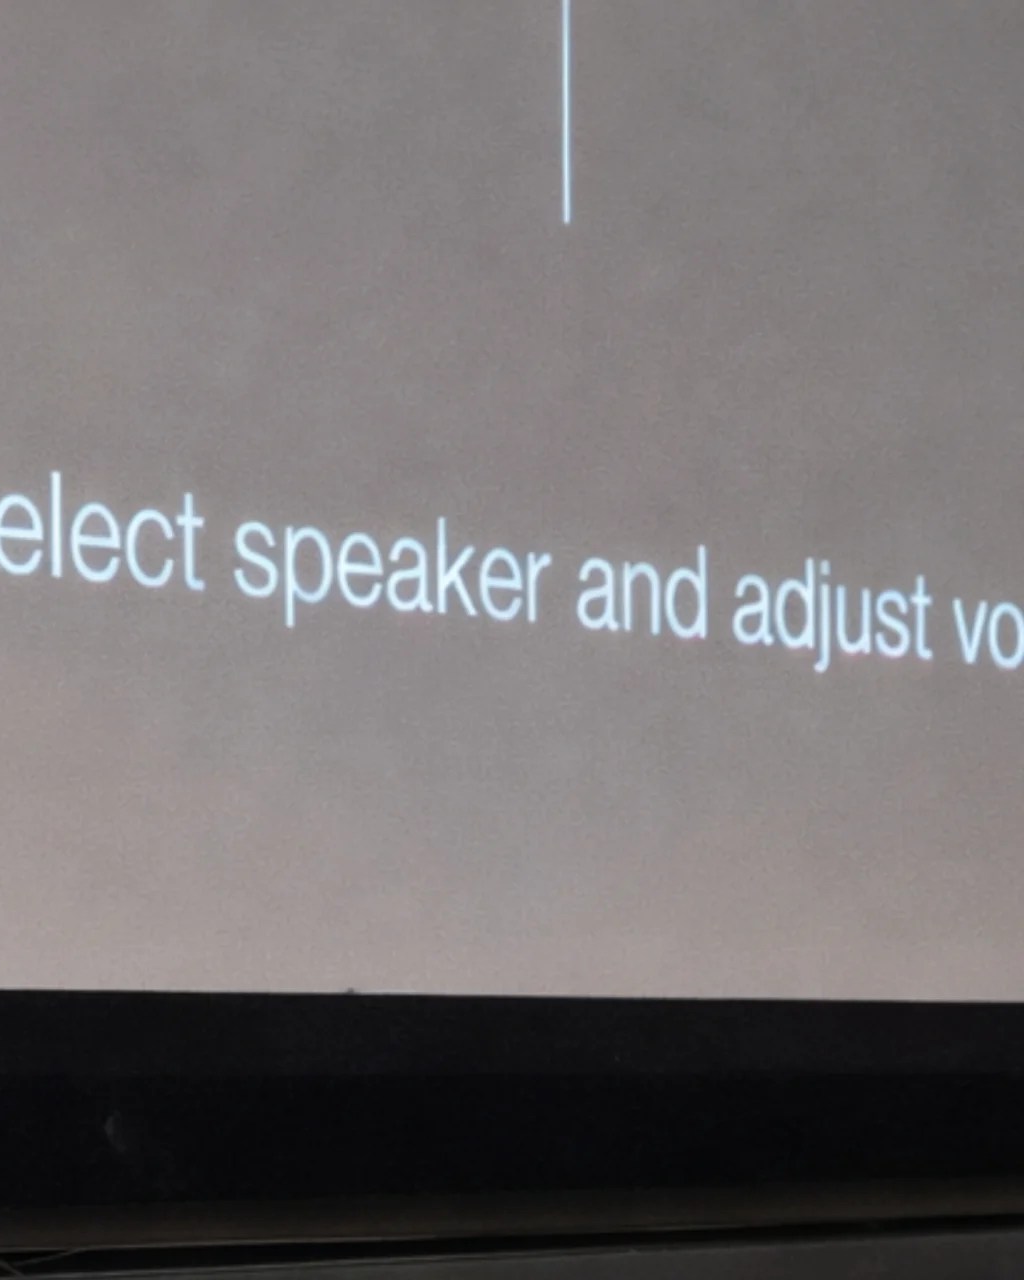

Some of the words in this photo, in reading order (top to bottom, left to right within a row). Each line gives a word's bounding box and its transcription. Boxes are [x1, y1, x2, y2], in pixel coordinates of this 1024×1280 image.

[233, 517, 552, 627] speaker
[576, 545, 708, 639] and
[732, 558, 933, 673] adjust
[952, 597, 1024, 670] vo
